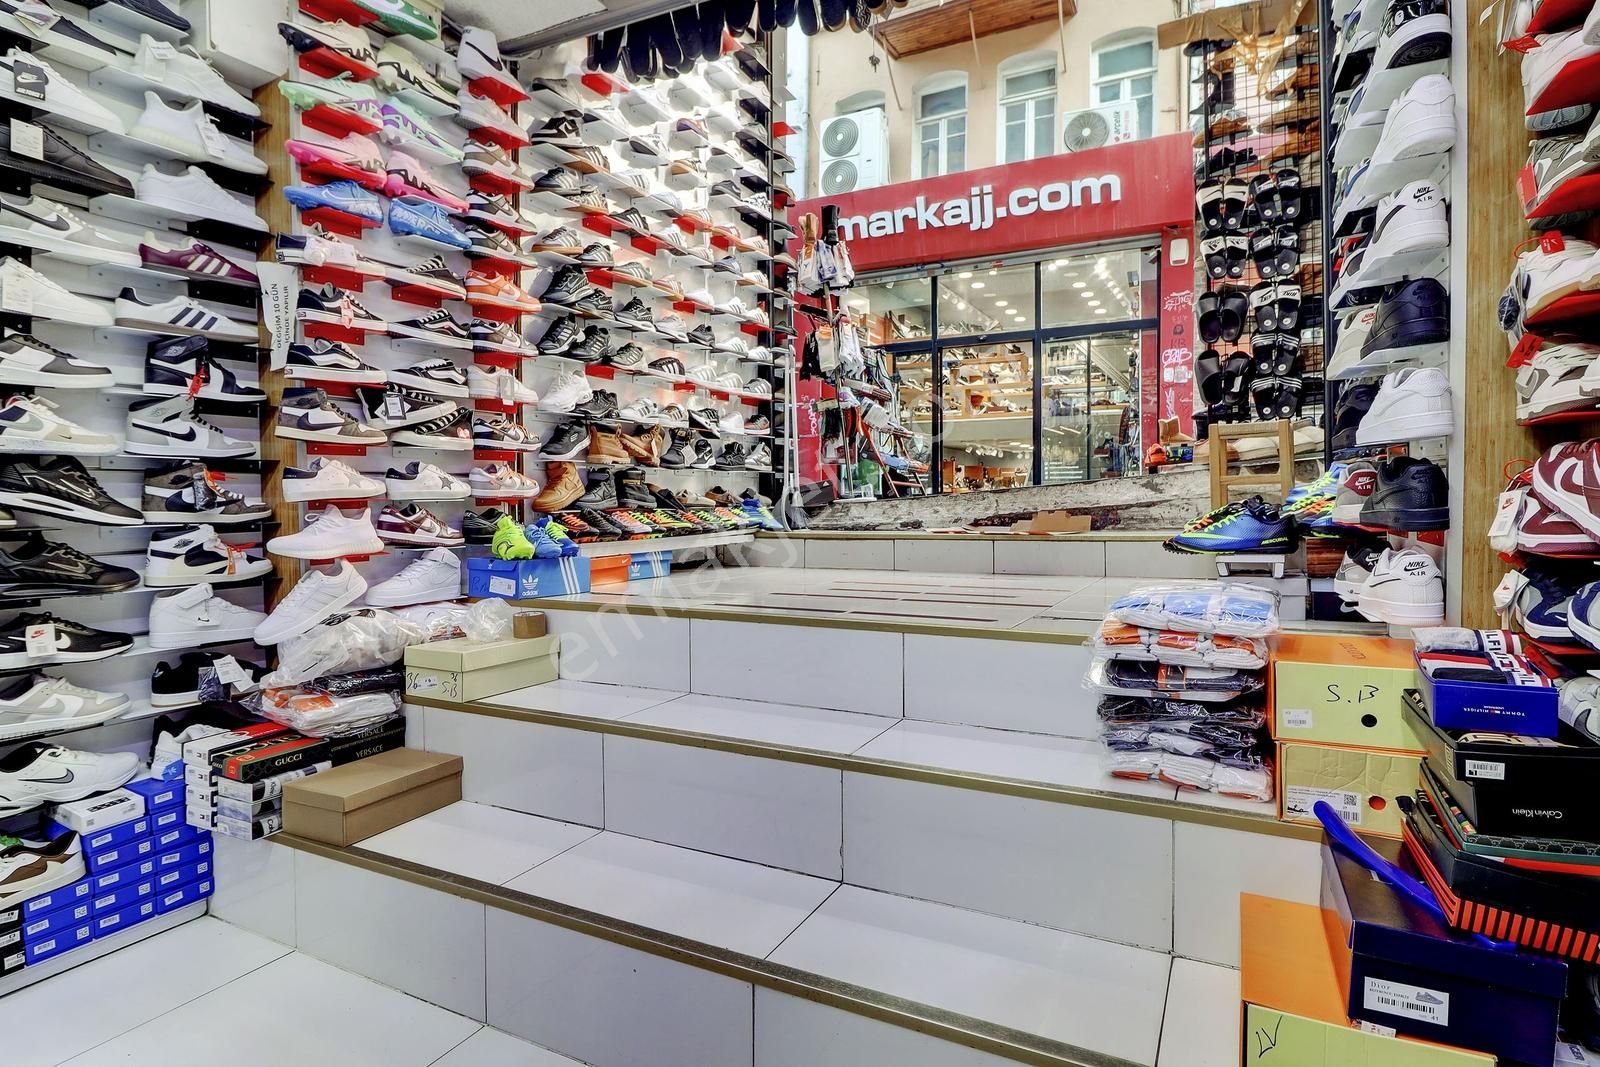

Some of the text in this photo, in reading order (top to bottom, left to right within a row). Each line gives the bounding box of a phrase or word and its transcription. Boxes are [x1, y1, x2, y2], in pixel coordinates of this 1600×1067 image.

[837, 172, 1122, 241] markajj.com
[355, 744, 384, 758] VERSACE
[275, 753, 303, 767] GUCCI
[1511, 807, 1563, 819] Calvin Klein
